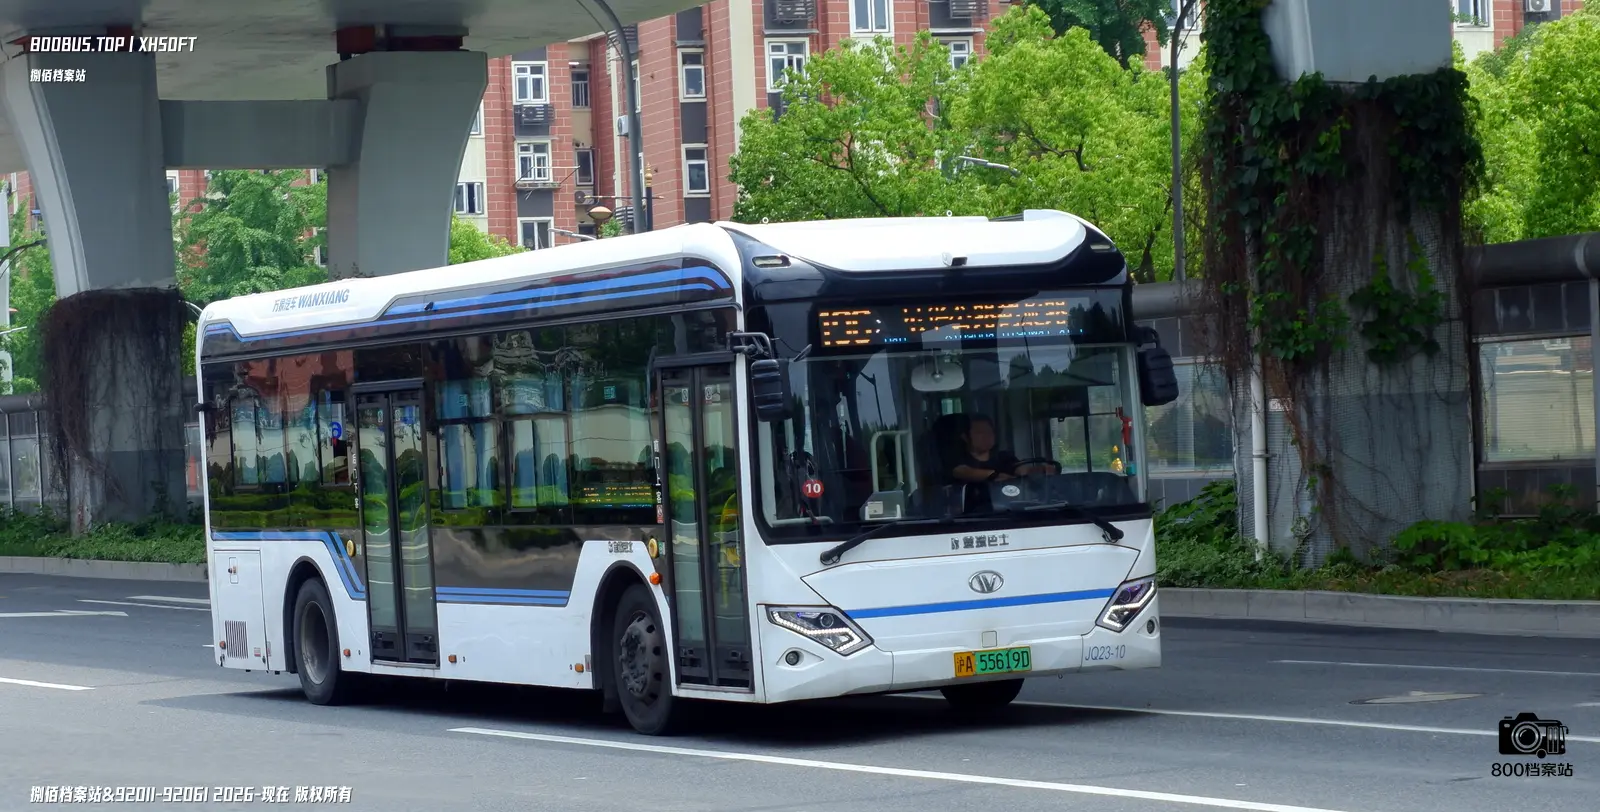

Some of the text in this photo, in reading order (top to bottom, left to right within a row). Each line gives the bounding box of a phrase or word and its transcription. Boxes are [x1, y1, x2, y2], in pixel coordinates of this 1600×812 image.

[297, 288, 350, 309] WANXIANG
[805, 483, 821, 494] 10
[979, 650, 1030, 671] 55619D
[1084, 644, 1126, 661] JQ23-10
